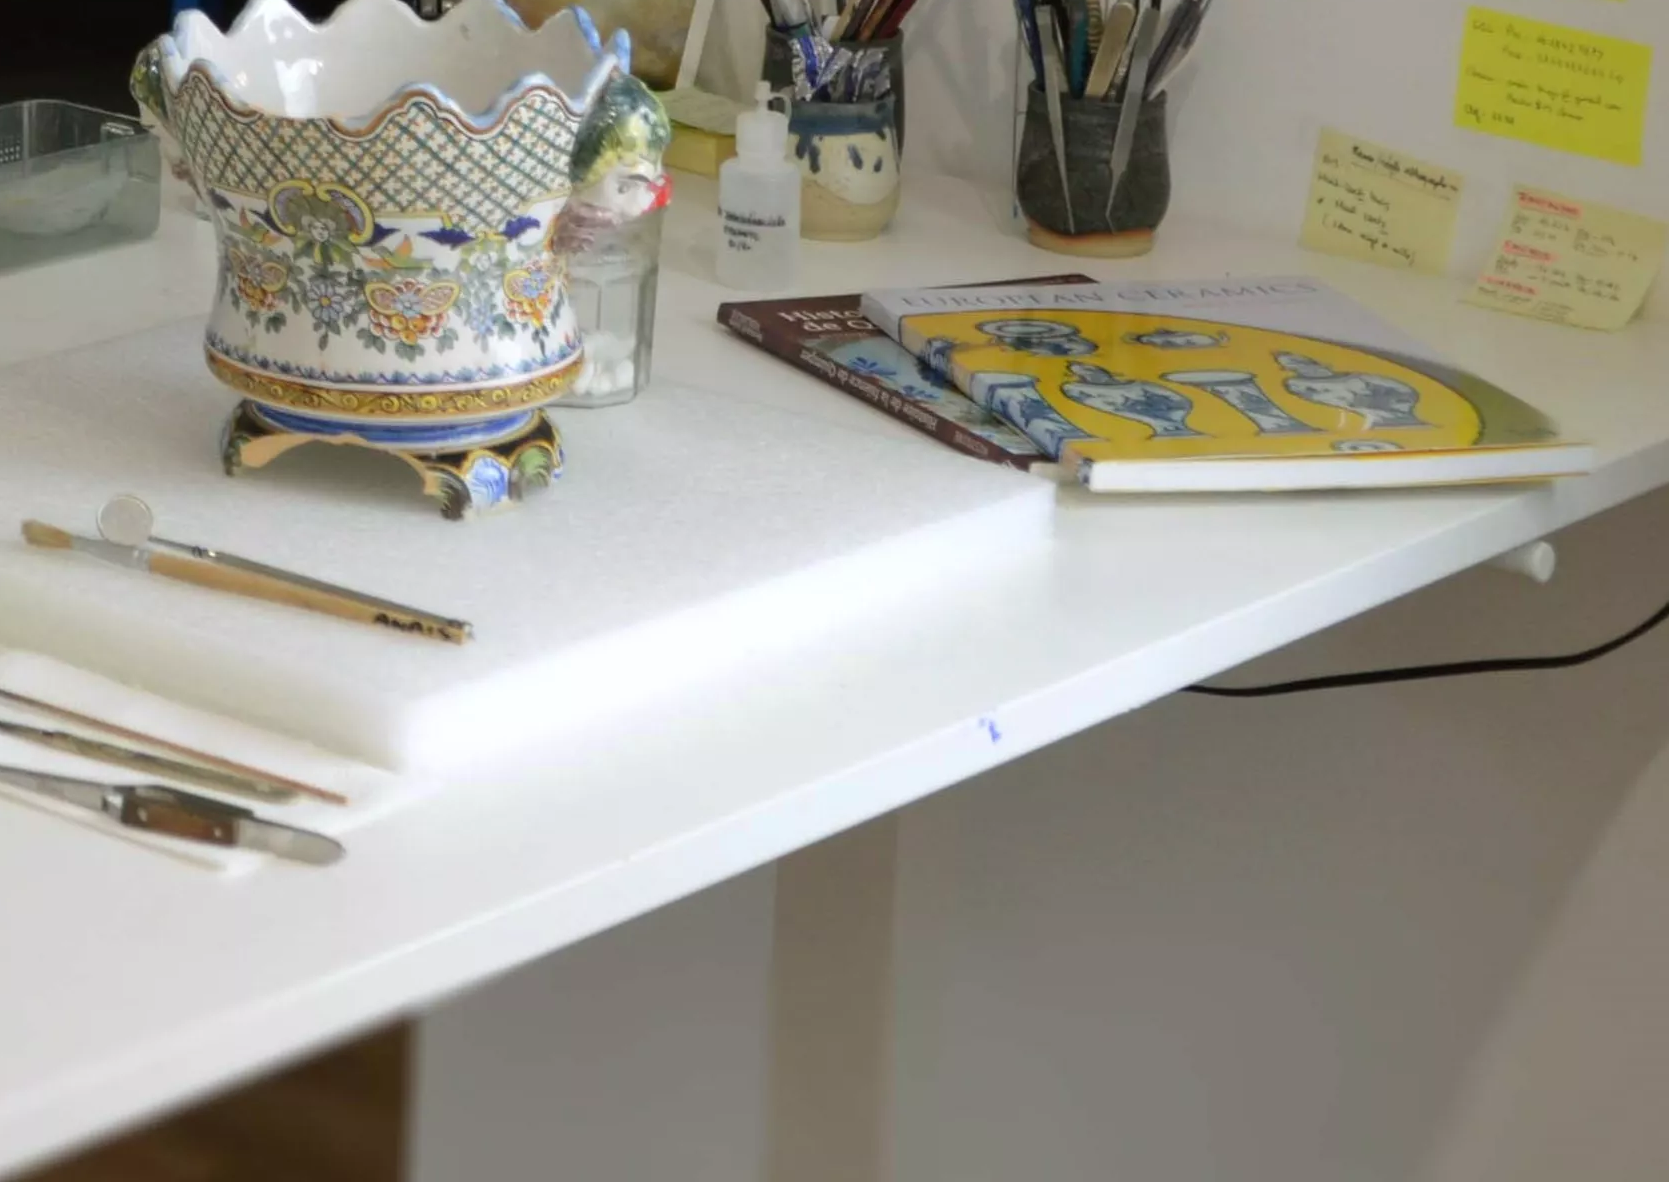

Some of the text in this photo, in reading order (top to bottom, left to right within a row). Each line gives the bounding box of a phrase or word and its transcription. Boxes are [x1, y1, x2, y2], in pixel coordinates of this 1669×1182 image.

[901, 280, 1320, 309] EUROPEAN CERAMICS
[802, 319, 843, 332] de
[836, 369, 849, 386] de
[889, 397, 903, 413] de
[901, 403, 939, 431] Histoire
